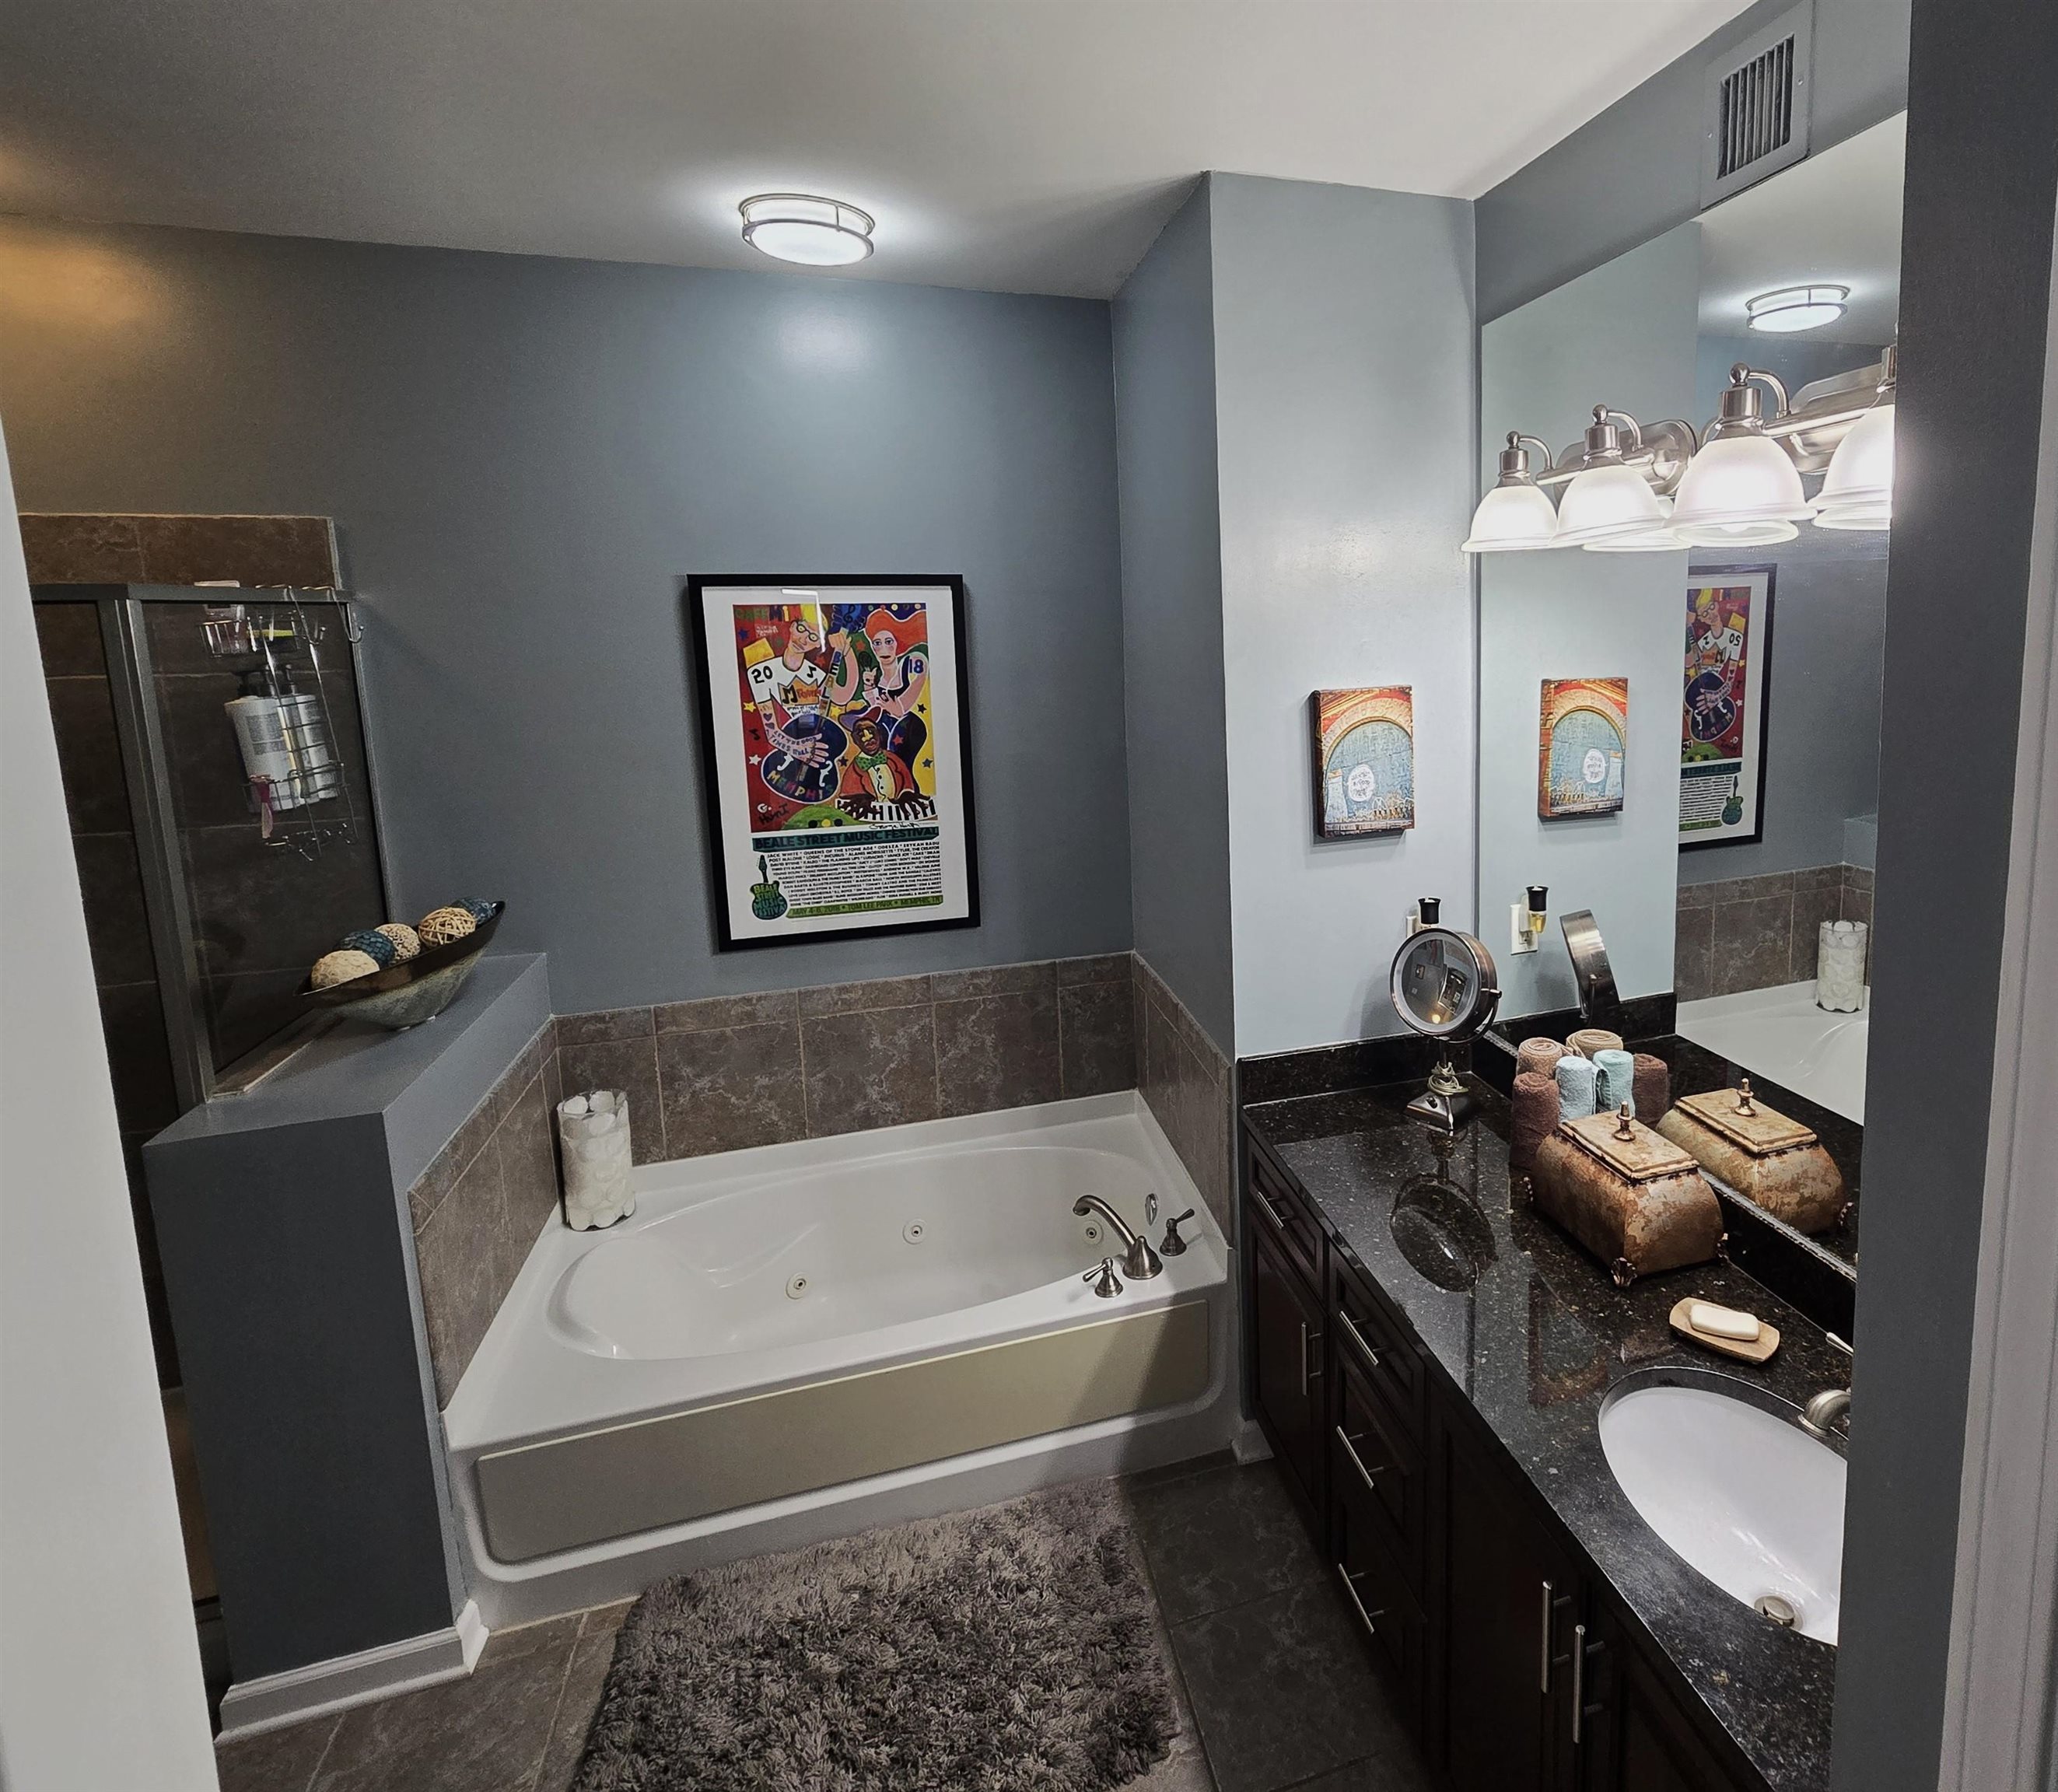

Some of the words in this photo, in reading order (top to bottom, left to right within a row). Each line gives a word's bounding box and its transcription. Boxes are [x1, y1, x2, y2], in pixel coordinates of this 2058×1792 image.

[751, 666, 773, 684] 20
[909, 658, 924, 674] 18
[756, 837, 795, 849] BEALE
[796, 834, 842, 846] STREET
[845, 831, 884, 843] MUSIC
[886, 827, 939, 839] FESTIVAL
